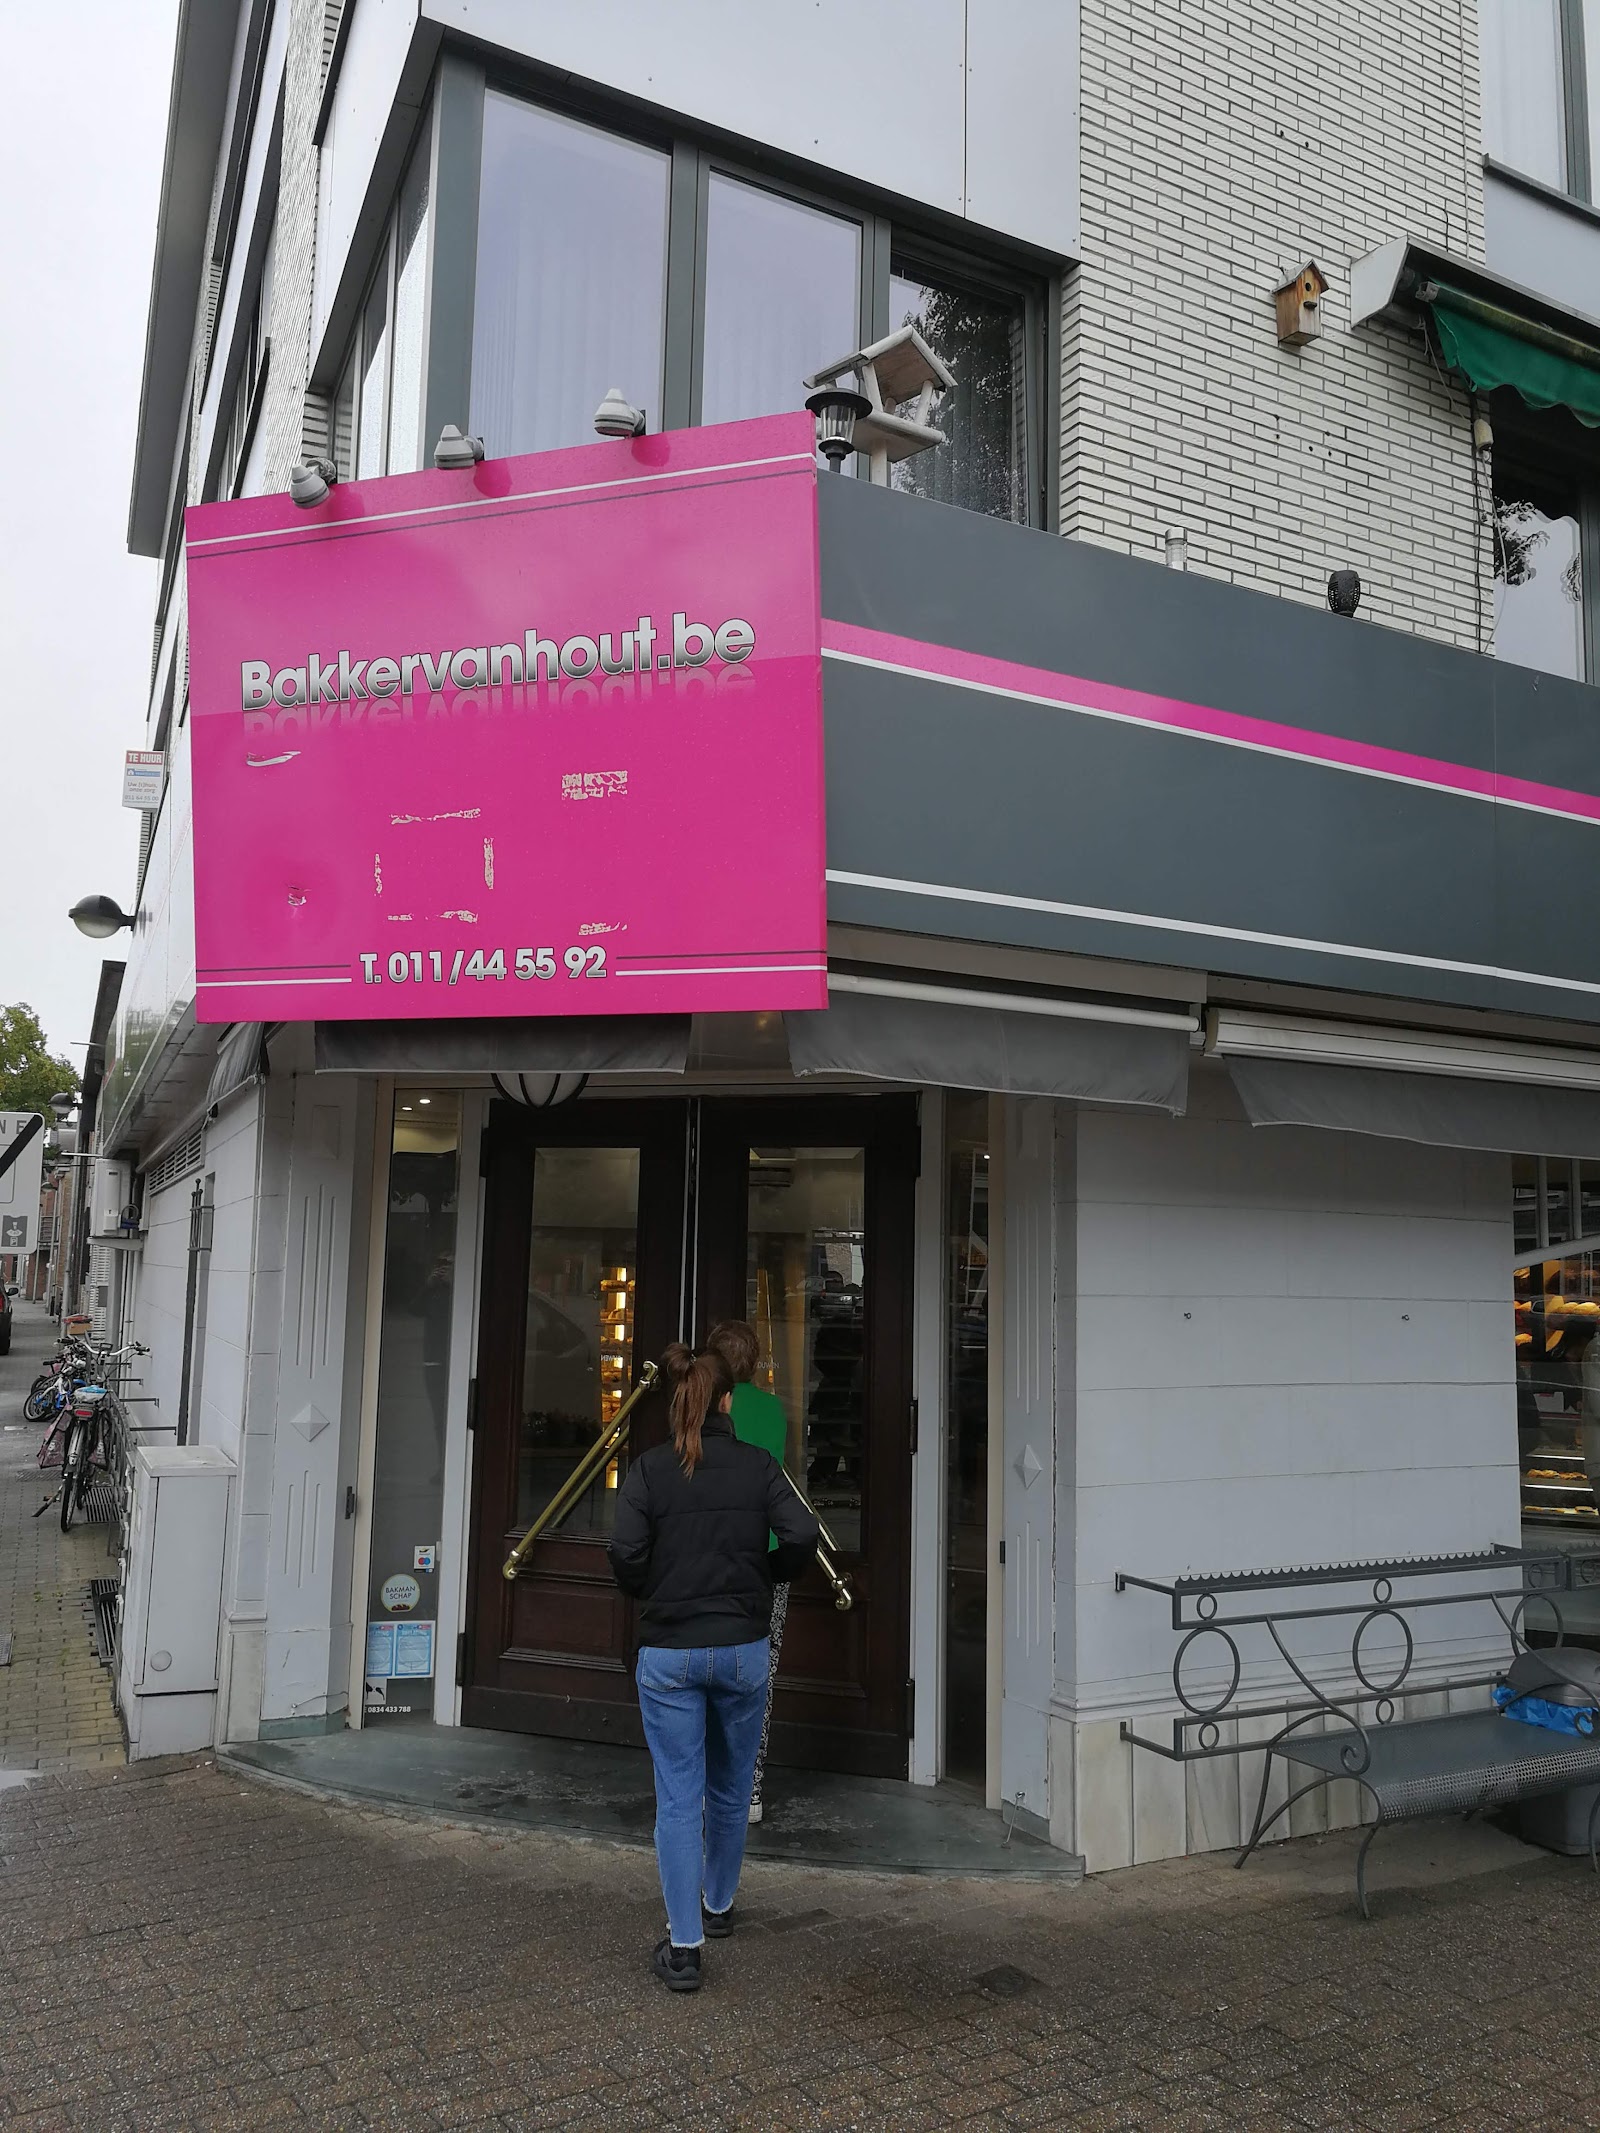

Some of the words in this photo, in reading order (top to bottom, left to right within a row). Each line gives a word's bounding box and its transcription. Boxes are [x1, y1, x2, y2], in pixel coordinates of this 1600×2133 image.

[241, 612, 756, 711] Bakkervanhout.be
[128, 753, 139, 763] TE
[140, 753, 162, 763] HUUR
[359, 953, 382, 984] T.
[388, 949, 508, 985] 011/44
[514, 947, 557, 980] 55
[563, 945, 608, 979] 92
[385, 1585, 416, 1594] BAKMAN
[389, 1592, 412, 1600] SCHAP
[398, 1705, 411, 1713] 788
